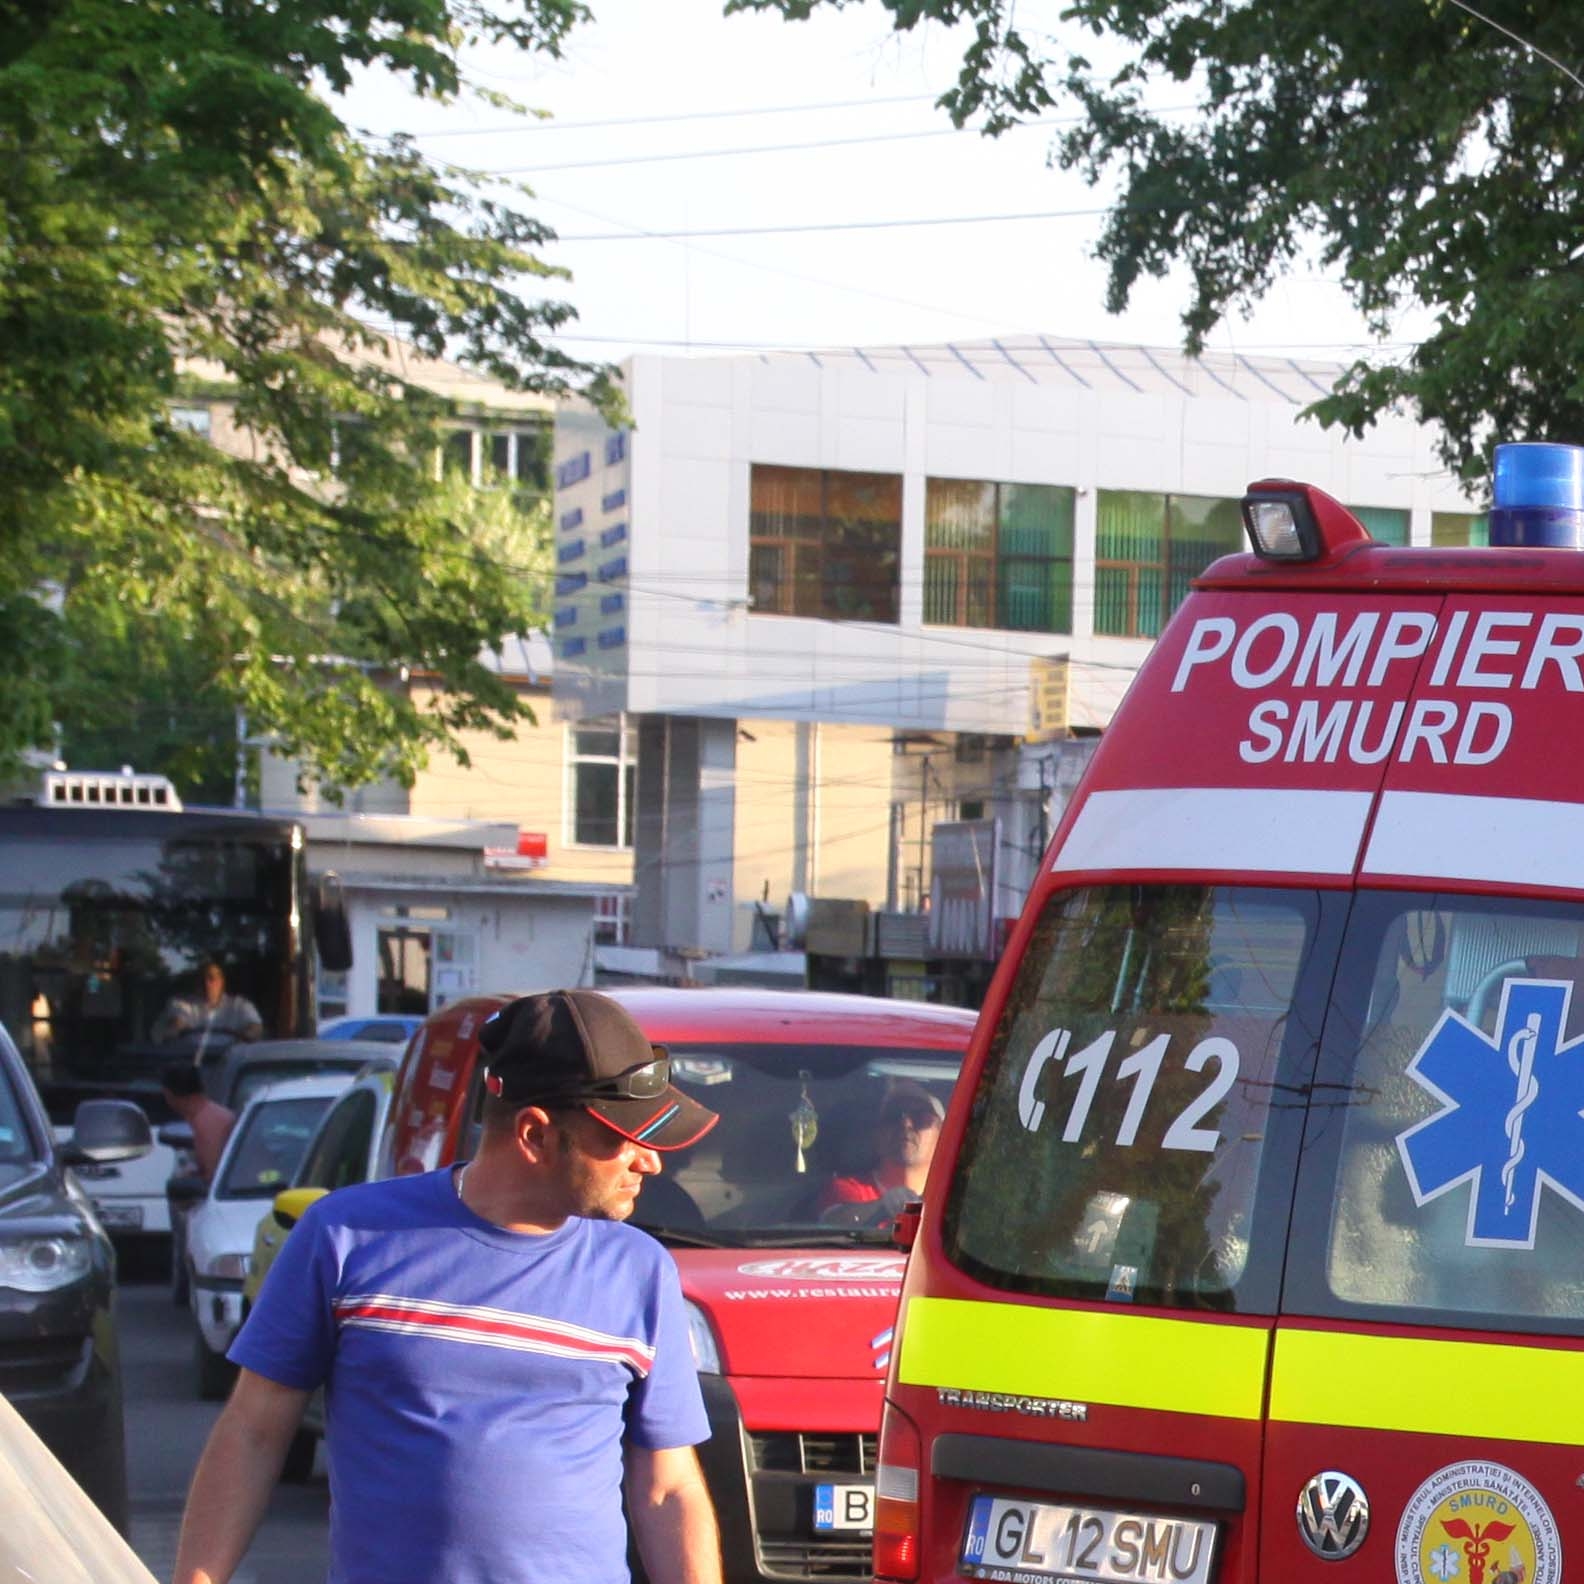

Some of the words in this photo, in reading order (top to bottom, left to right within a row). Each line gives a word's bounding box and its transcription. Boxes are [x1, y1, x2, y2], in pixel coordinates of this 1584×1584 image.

[1239, 700, 1513, 764] SMURD
[937, 1387, 1087, 1421] TRANSPORTER
[816, 1509, 832, 1523] RO
[845, 1490, 868, 1522] B
[1401, 1487, 1433, 1542] MINISTERUL
[1449, 1494, 1509, 1515] SMURD
[965, 1533, 985, 1556] RO
[995, 1508, 1044, 1564] GL
[990, 1570, 1011, 1582] ADA
